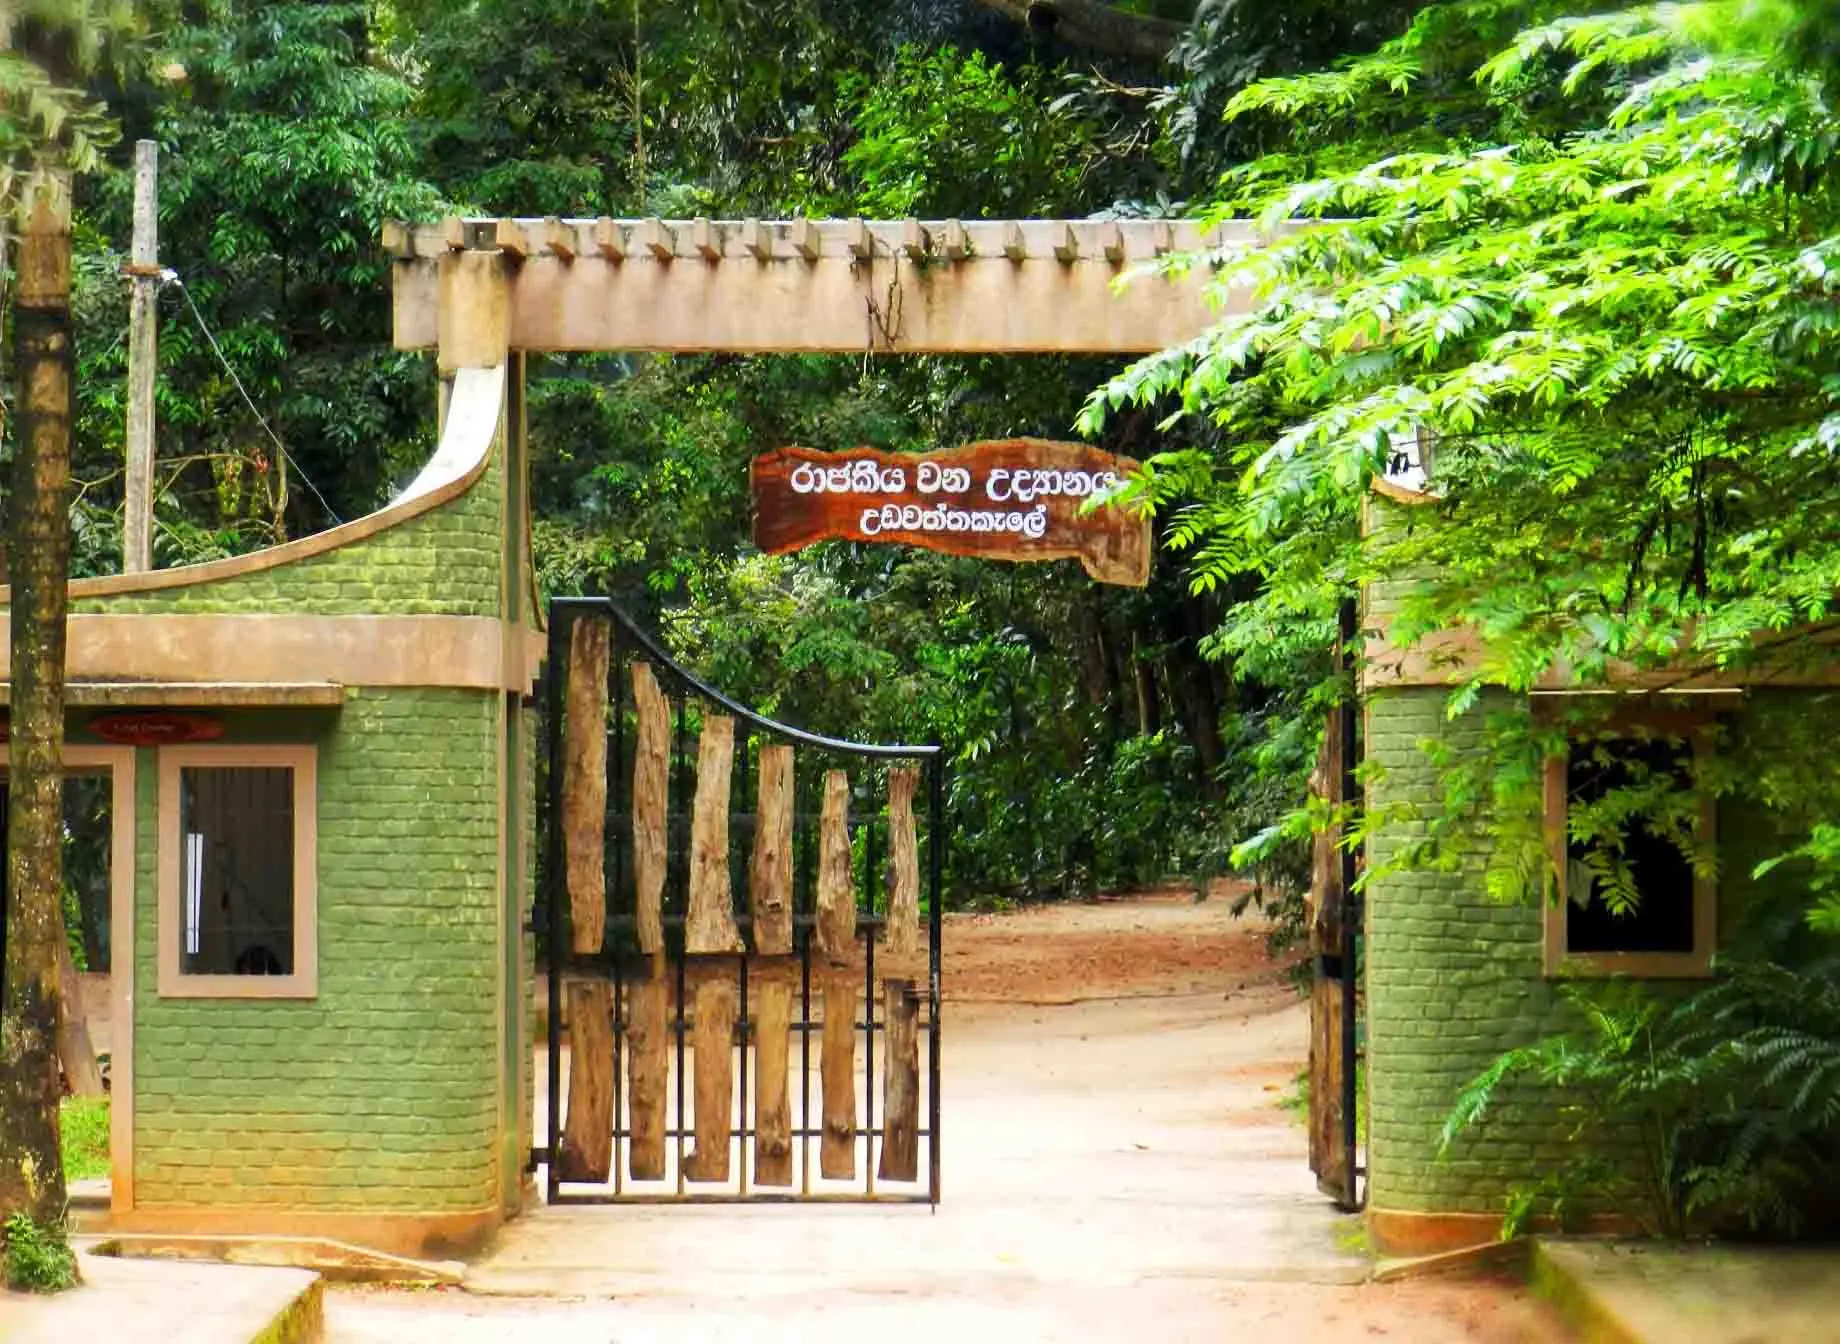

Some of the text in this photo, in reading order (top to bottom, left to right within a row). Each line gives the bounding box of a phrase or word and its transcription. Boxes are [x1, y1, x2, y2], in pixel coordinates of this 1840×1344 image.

[790, 459, 907, 494] රාජකීය
[916, 461, 971, 494] වන
[859, 503, 1047, 539] උඩවත්තකැලේ
